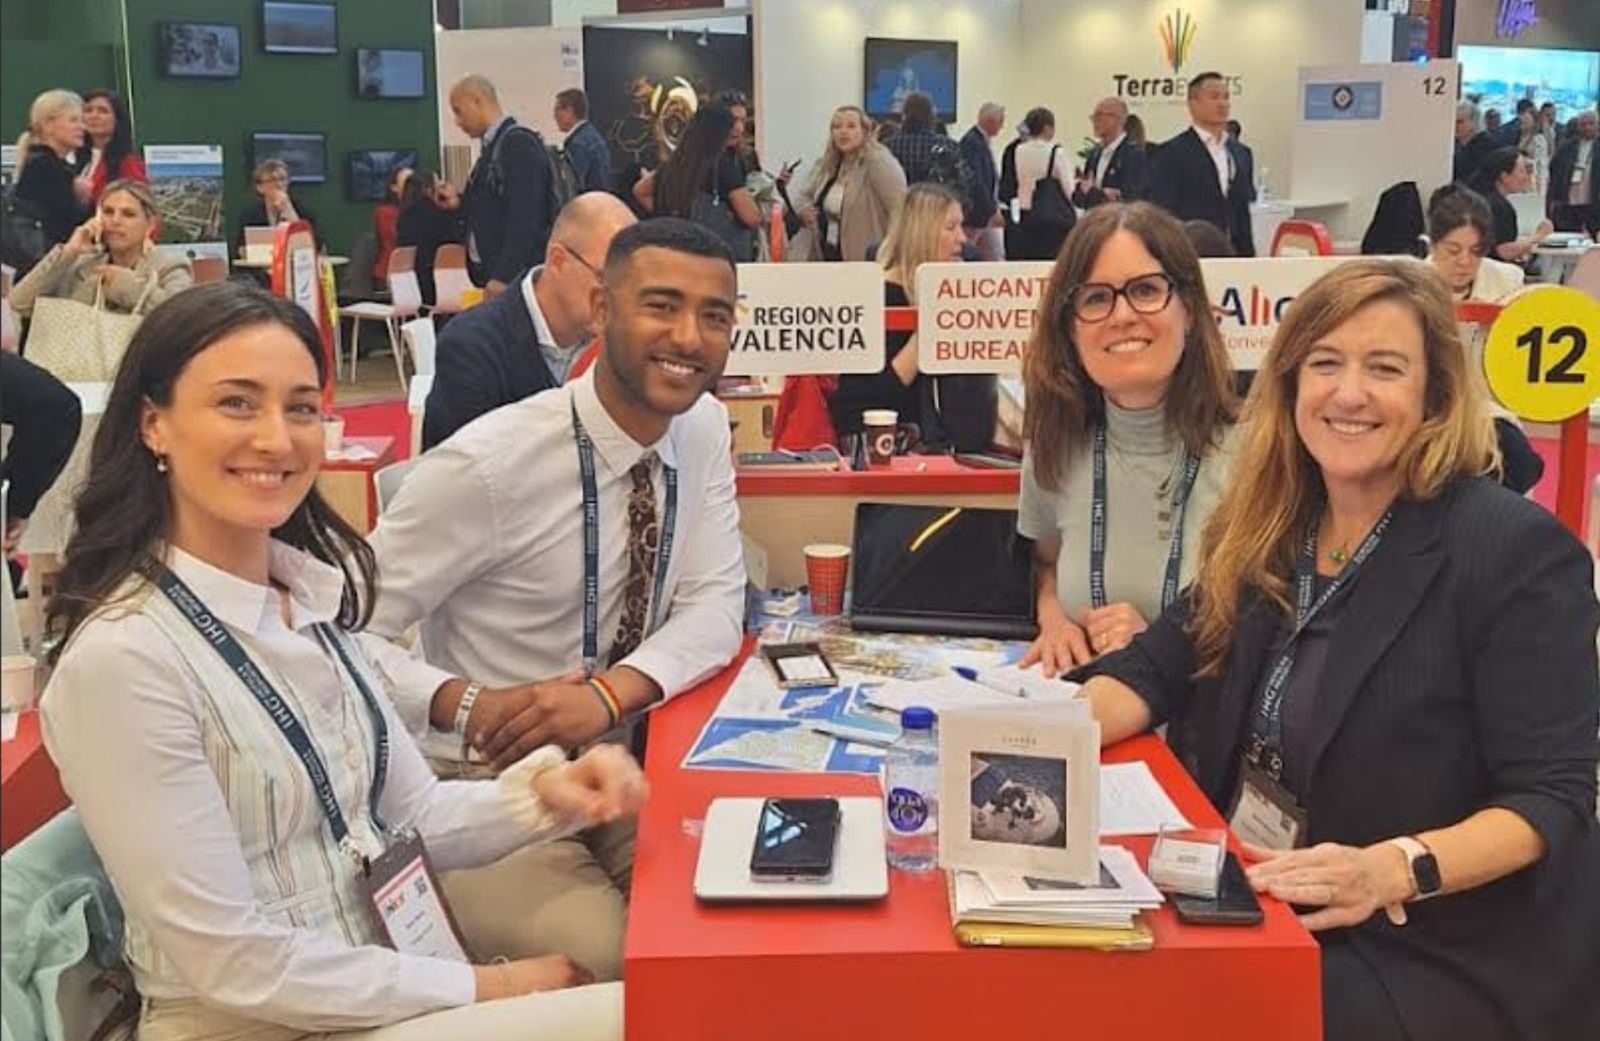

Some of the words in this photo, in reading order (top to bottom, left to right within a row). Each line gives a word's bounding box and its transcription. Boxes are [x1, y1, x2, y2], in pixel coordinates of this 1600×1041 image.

[1113, 75, 1242, 97] TerraETS
[1423, 76, 1446, 95] 12
[754, 306, 833, 326] REGION
[838, 305, 865, 325] OF
[729, 327, 866, 351] VALENCIA
[936, 340, 1027, 360] BUREA
[1516, 326, 1588, 384] 12
[194, 614, 228, 644] IHG
[264, 697, 294, 729] IHG
